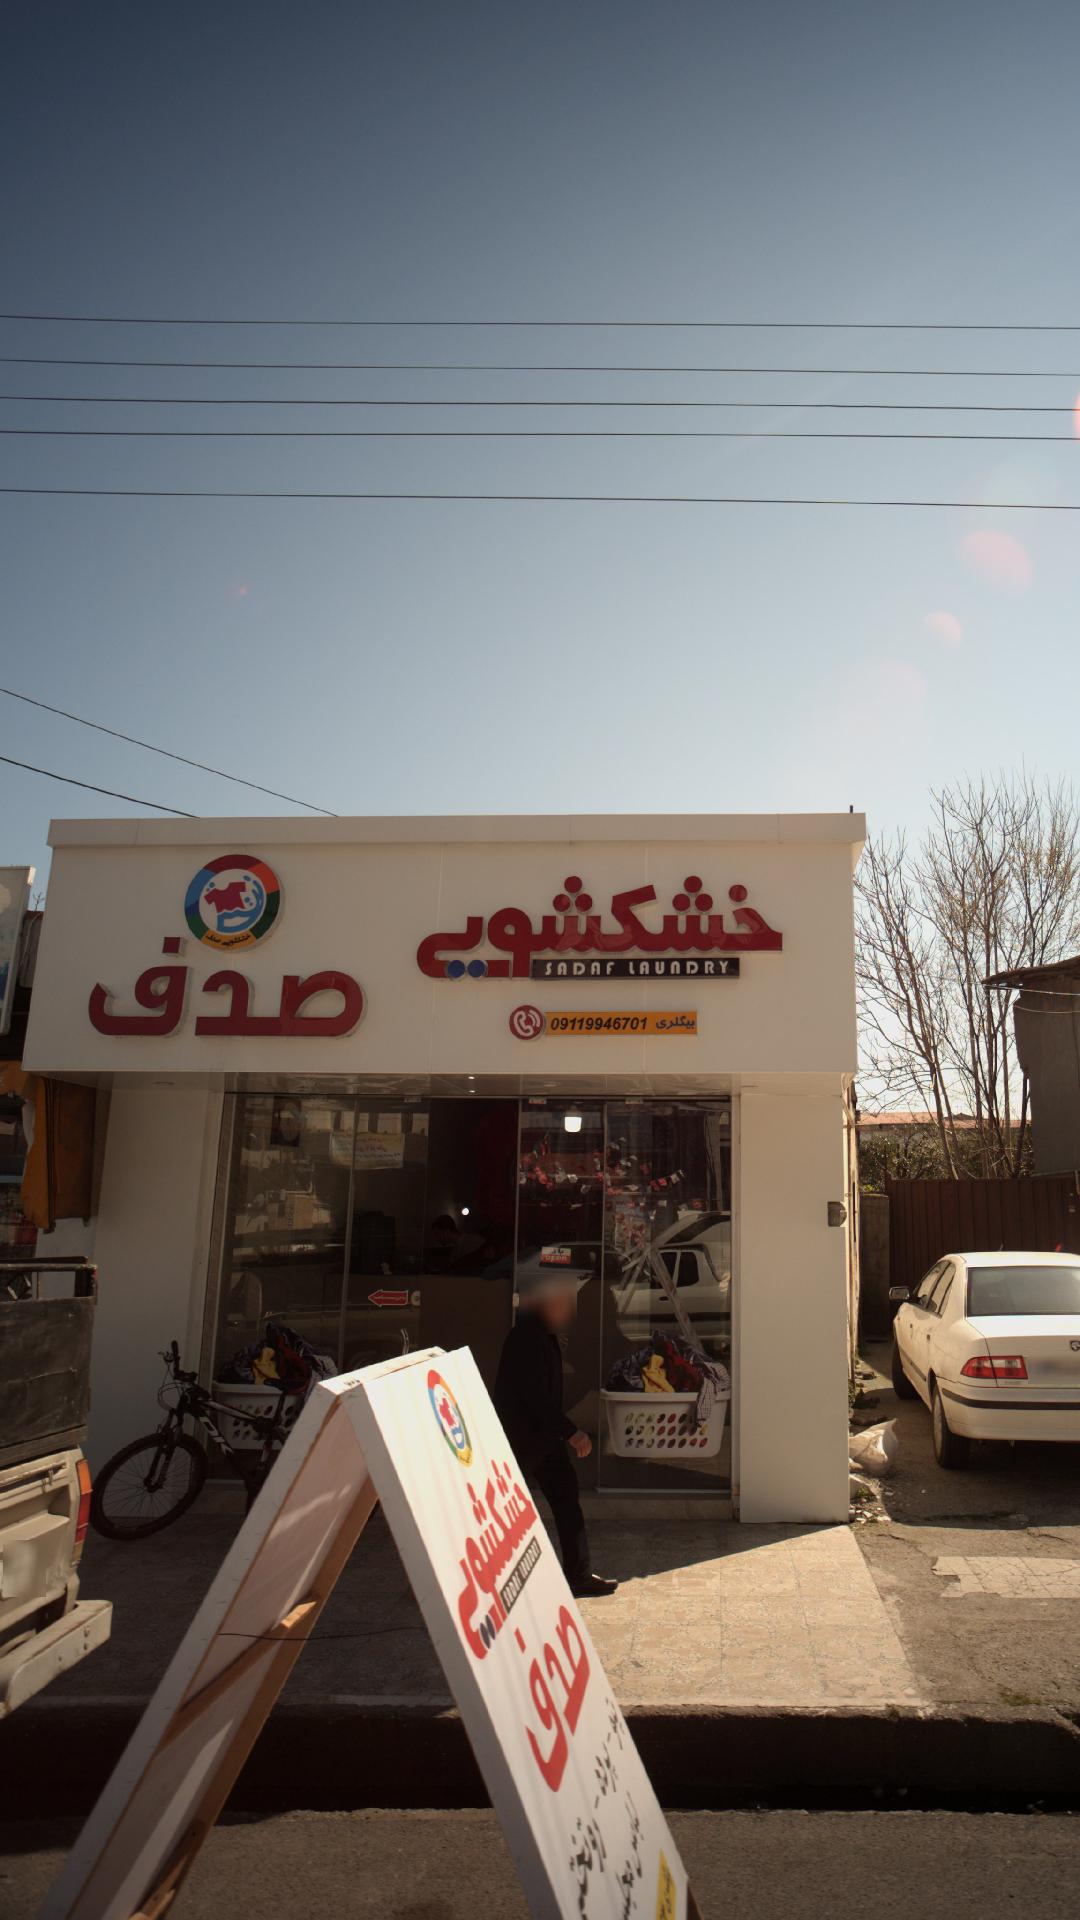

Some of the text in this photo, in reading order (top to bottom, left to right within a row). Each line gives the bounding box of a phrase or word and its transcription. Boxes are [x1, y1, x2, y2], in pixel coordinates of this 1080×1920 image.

[88, 936, 365, 1037] صدف
[544, 960, 729, 976] SADAF LAUNDRY
[550, 1015, 696, 1031] 09119946701 بیگلری
[514, 1605, 590, 1793] صدف
